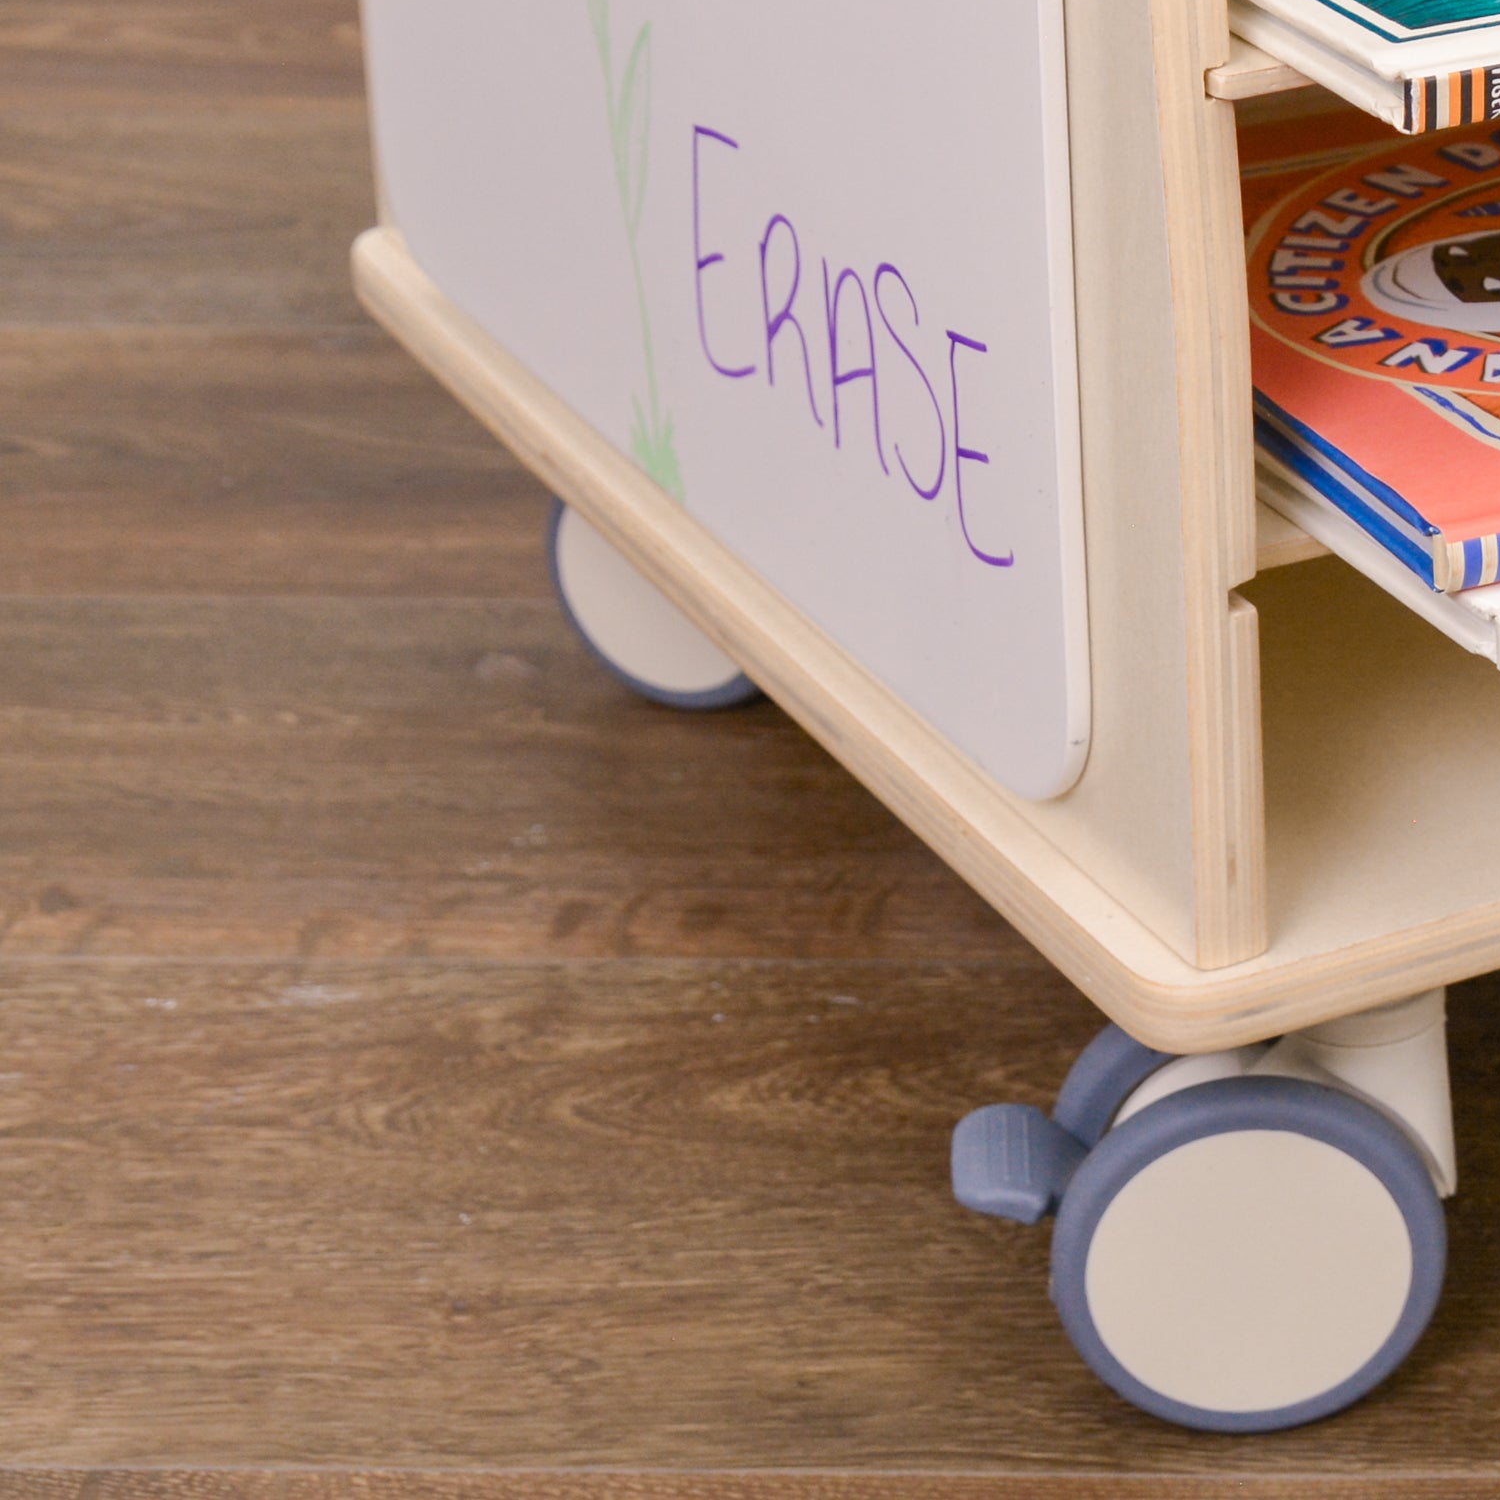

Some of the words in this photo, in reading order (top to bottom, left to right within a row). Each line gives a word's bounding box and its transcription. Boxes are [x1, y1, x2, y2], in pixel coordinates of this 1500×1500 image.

[1268, 162, 1451, 316] CITIZEN
[691, 123, 1015, 568] ERASE
[1311, 316, 1403, 349] A
